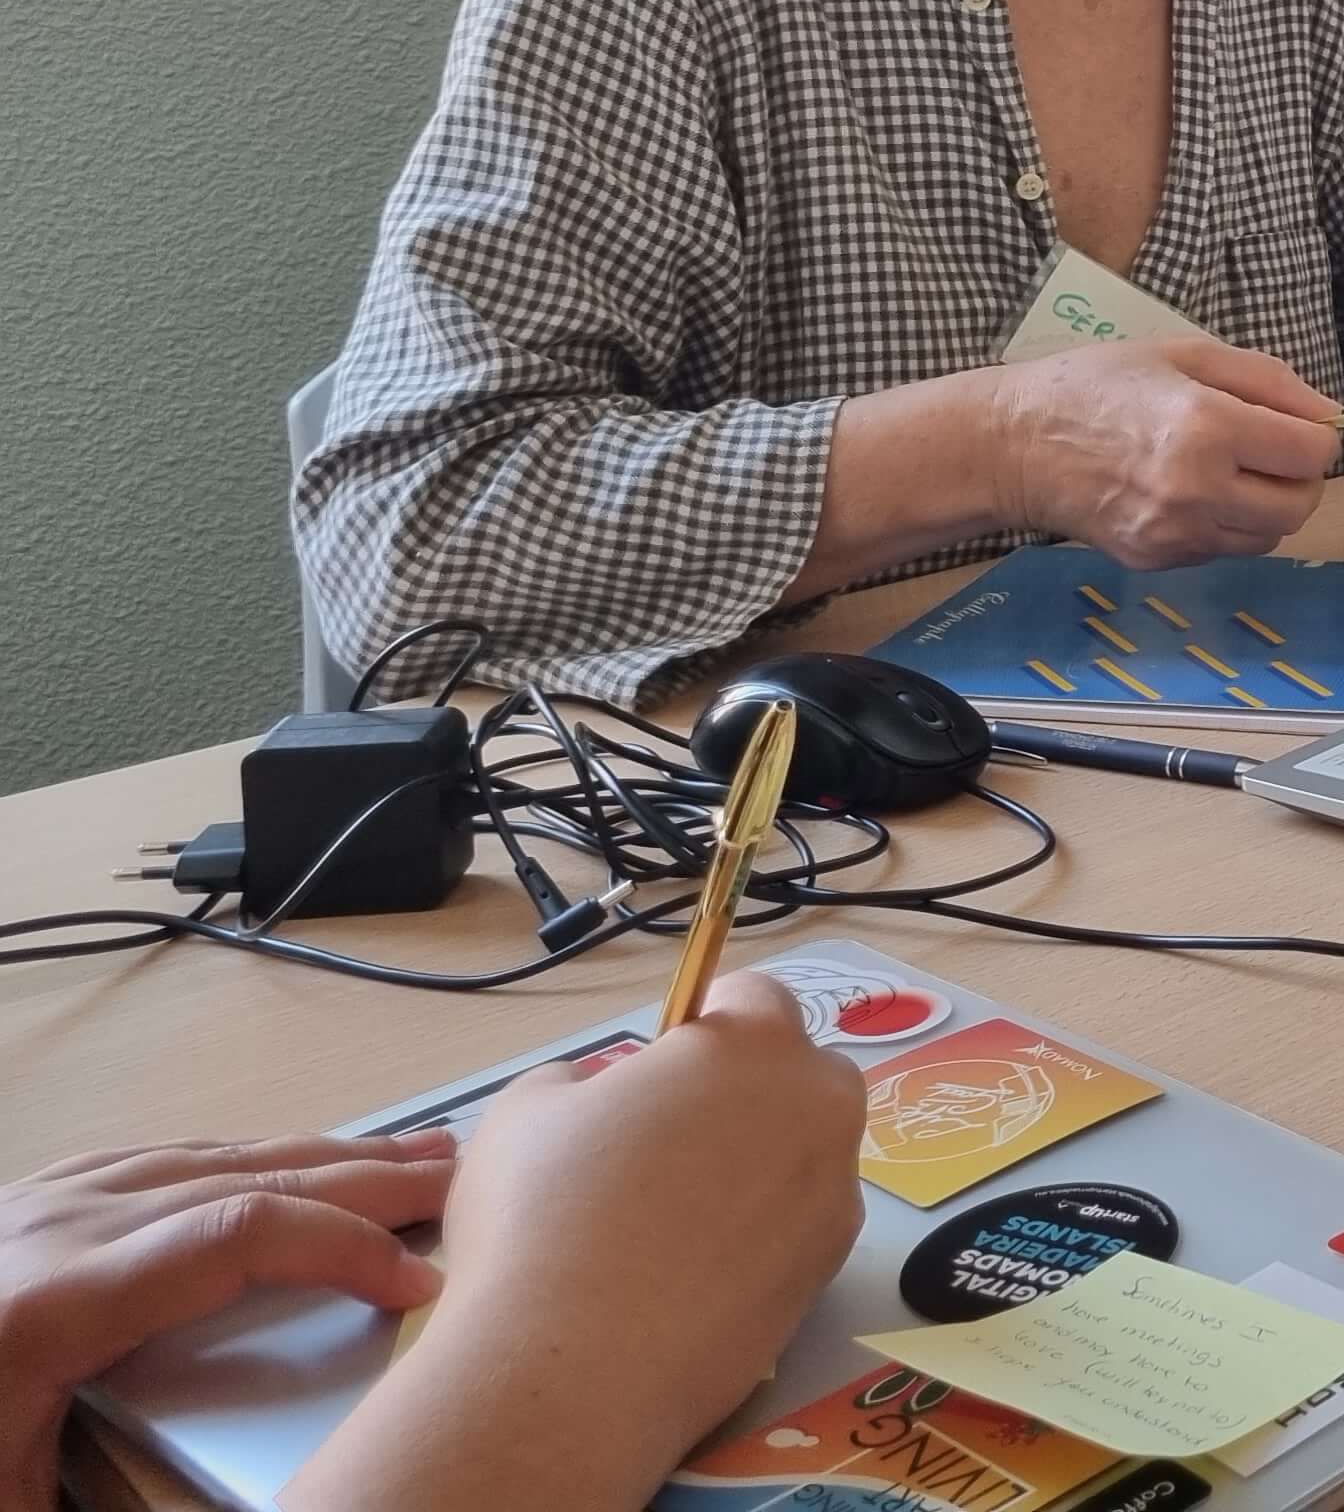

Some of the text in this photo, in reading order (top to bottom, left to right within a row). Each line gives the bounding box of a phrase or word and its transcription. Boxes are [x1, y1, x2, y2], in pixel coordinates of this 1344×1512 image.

[1053, 293, 1128, 341] GER
[1079, 1203, 1141, 1224] startup
[1060, 1298, 1222, 1369] have meetings
[1122, 1275, 1279, 1343] Sometimes I
[850, 1413, 1029, 1512] LIVING
